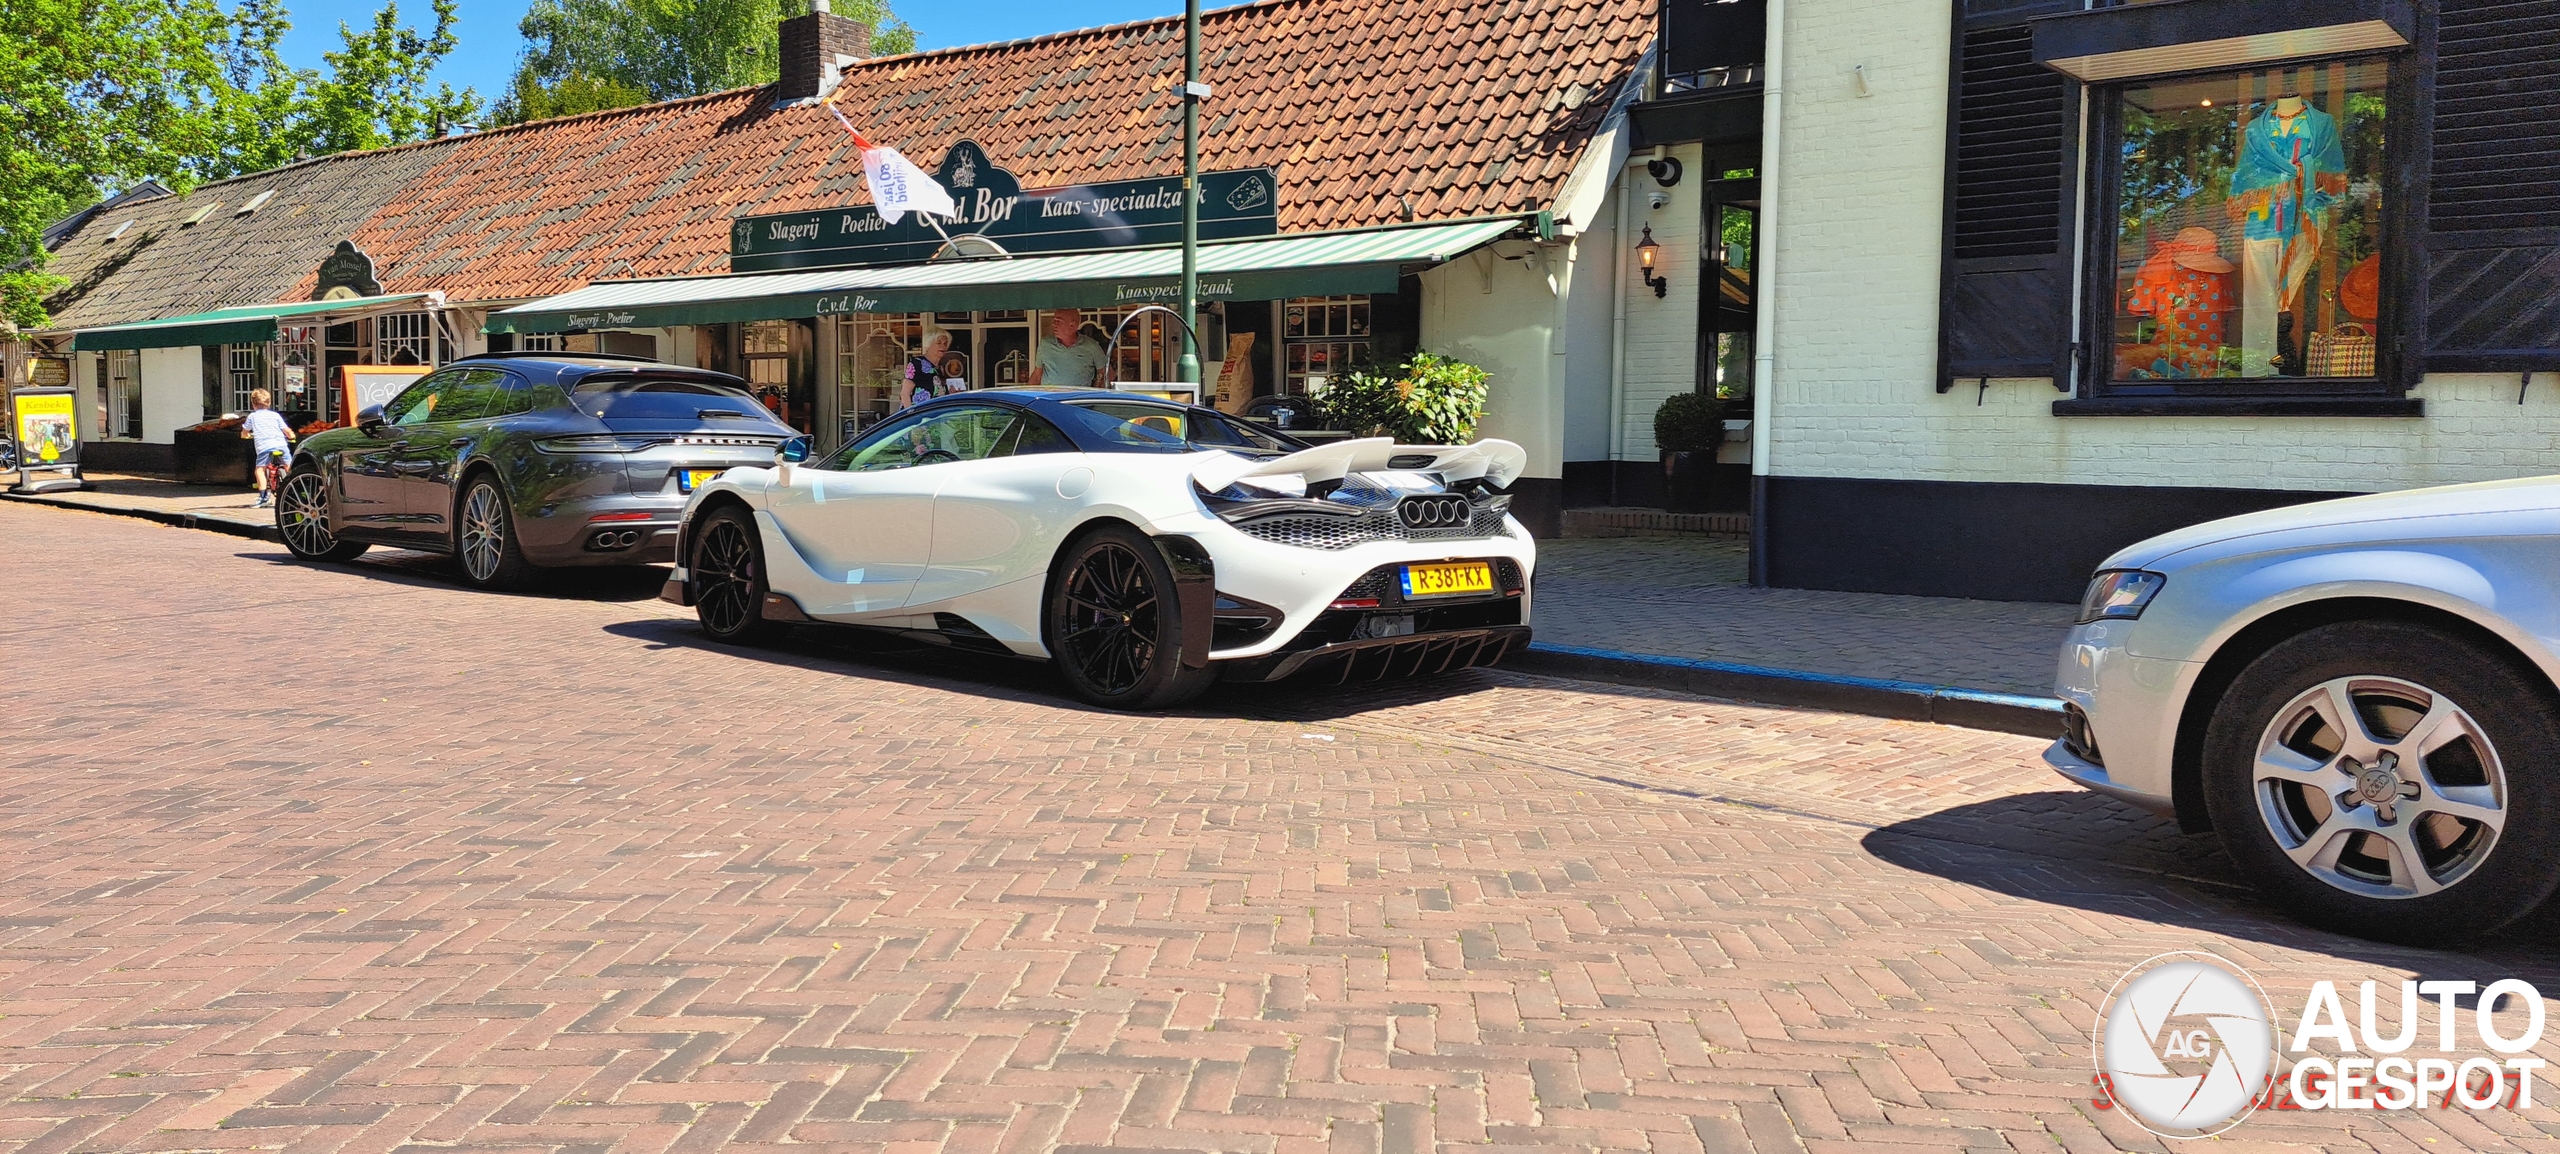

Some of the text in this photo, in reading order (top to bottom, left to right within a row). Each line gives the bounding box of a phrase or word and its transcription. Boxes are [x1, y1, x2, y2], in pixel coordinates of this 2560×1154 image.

[972, 187, 1018, 223] Bor
[1040, 182, 1208, 218] Kaas-speciaalzak
[768, 212, 888, 242] Slagerij Poelier
[1115, 278, 1234, 301] Kaasspecilzaak
[816, 295, 878, 314] C.v.d. Bor
[606, 311, 636, 325] Poelier
[24, 400, 68, 409] Kesbeke
[1418, 565, 1485, 590] R-381-KX
